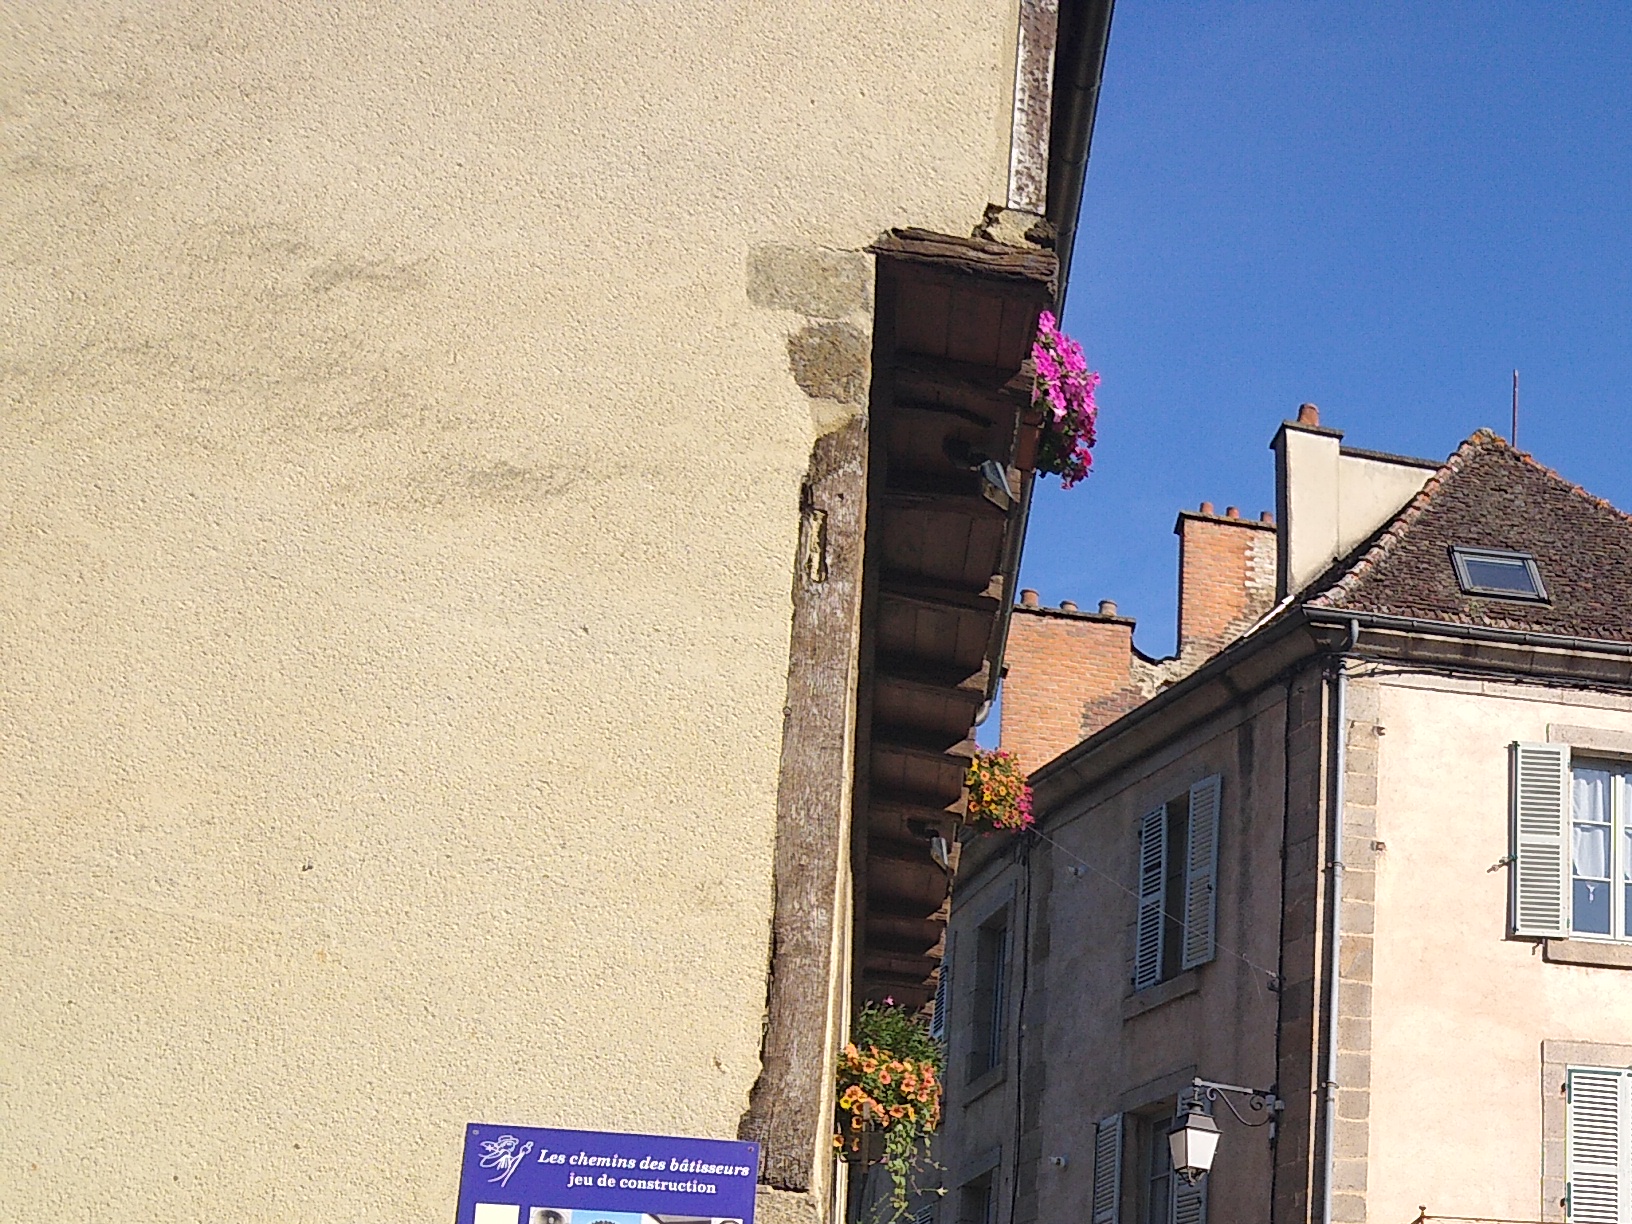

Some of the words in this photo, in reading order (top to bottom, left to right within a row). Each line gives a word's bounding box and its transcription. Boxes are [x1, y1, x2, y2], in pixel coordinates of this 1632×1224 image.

[537, 1150, 565, 1164] Les
[569, 1154, 635, 1169] chemins
[639, 1156, 666, 1171] des
[670, 1158, 750, 1176] bâtisseurs
[567, 1172, 593, 1187] jeu
[597, 1174, 616, 1187] de
[619, 1177, 717, 1194] construction
